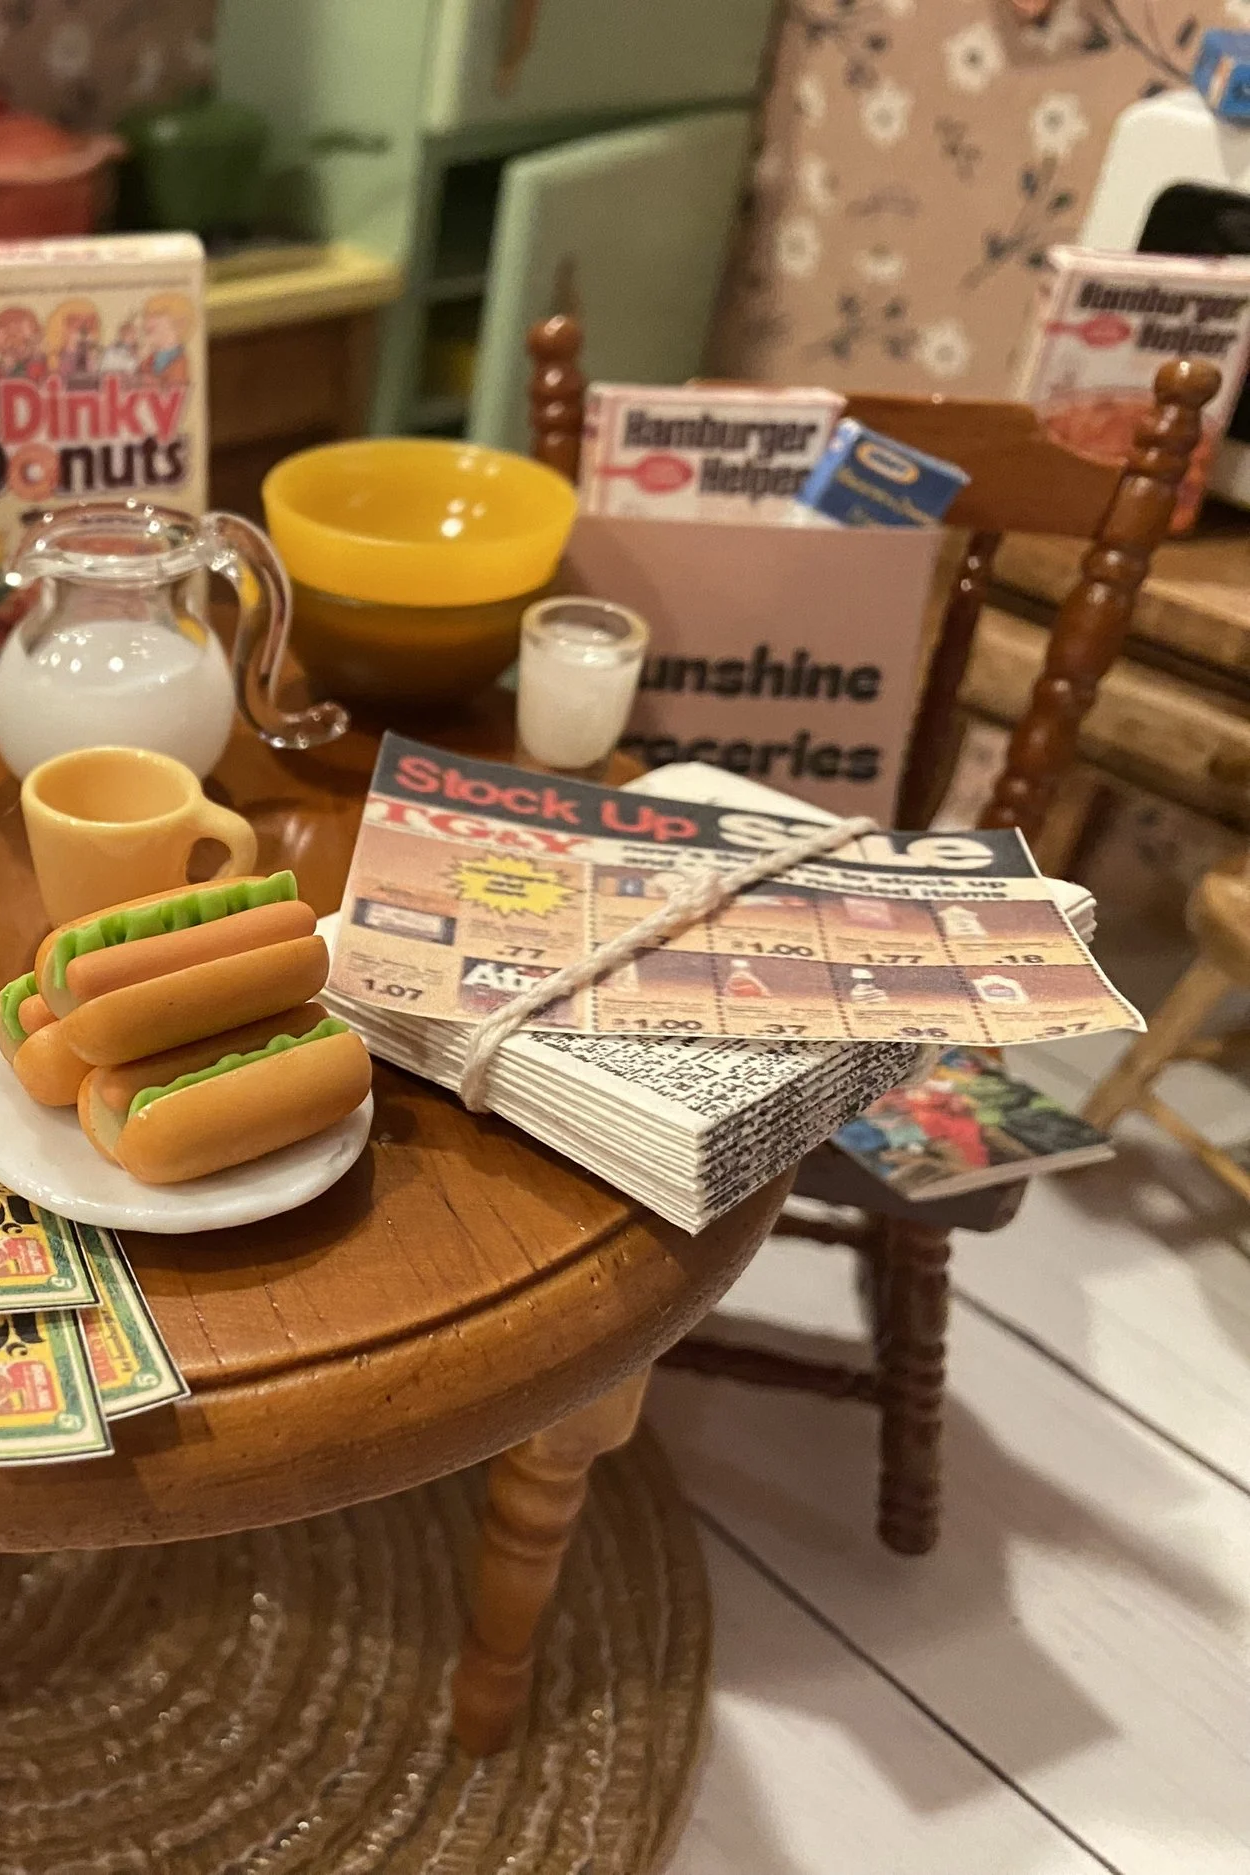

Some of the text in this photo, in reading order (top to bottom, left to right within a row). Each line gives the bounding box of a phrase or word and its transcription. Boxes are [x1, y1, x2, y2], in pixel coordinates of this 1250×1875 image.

[1, 372, 187, 443] Dinky
[625, 410, 817, 458] Hamburger
[638, 645, 883, 701] unshine
[393, 753, 582, 827] Stock
[600, 800, 699, 843] Up
[361, 979, 423, 1000] 1.07
[52, 1275, 74, 1290] 5
[58, 1413, 82, 1431] 5
